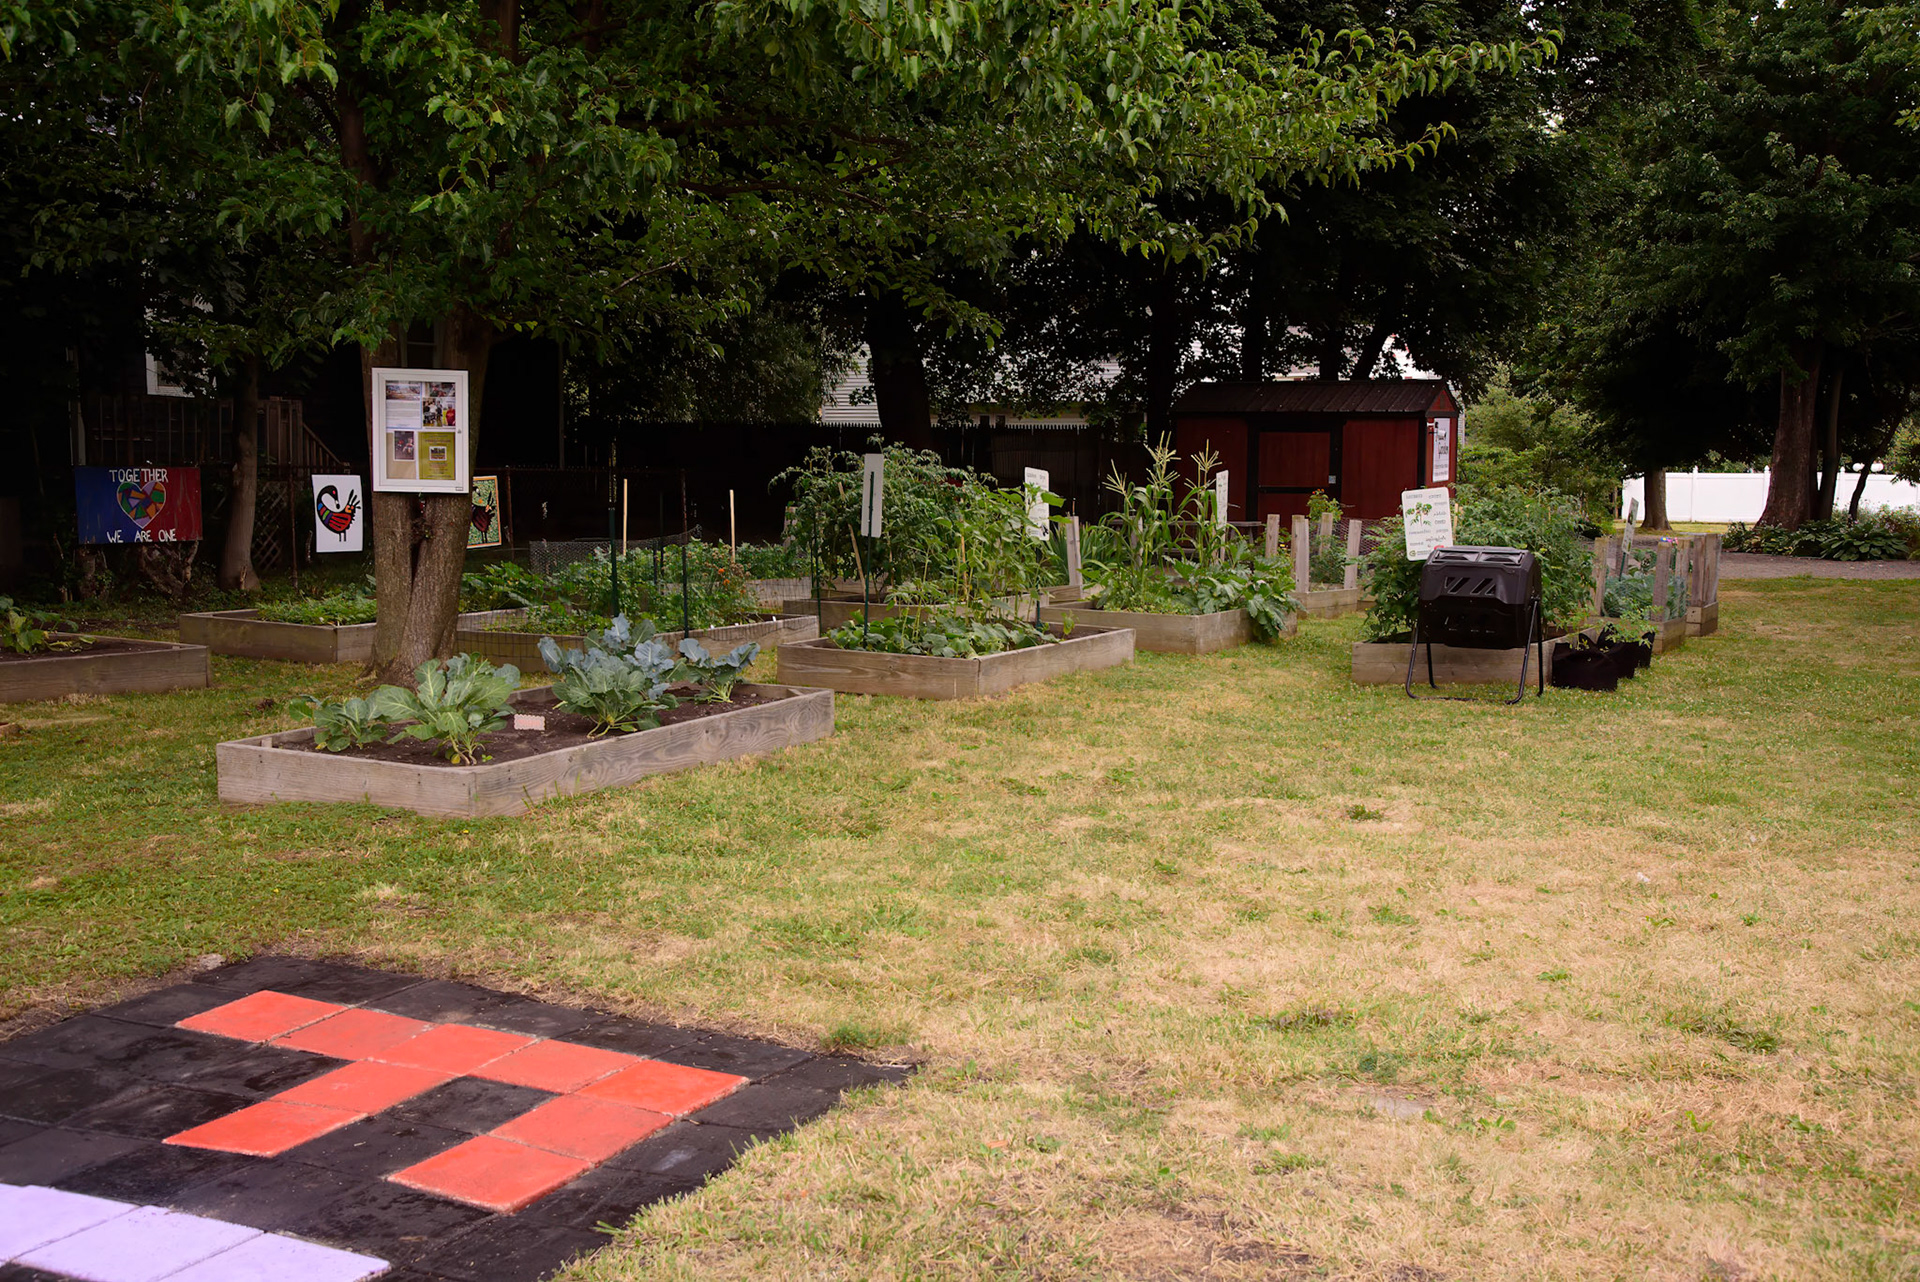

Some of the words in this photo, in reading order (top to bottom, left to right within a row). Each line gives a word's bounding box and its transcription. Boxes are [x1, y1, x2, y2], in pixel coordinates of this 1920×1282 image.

[109, 468, 168, 483] TOGETHER
[106, 529, 123, 543] WE
[134, 529, 153, 542] ARE
[158, 528, 177, 542] ONE
